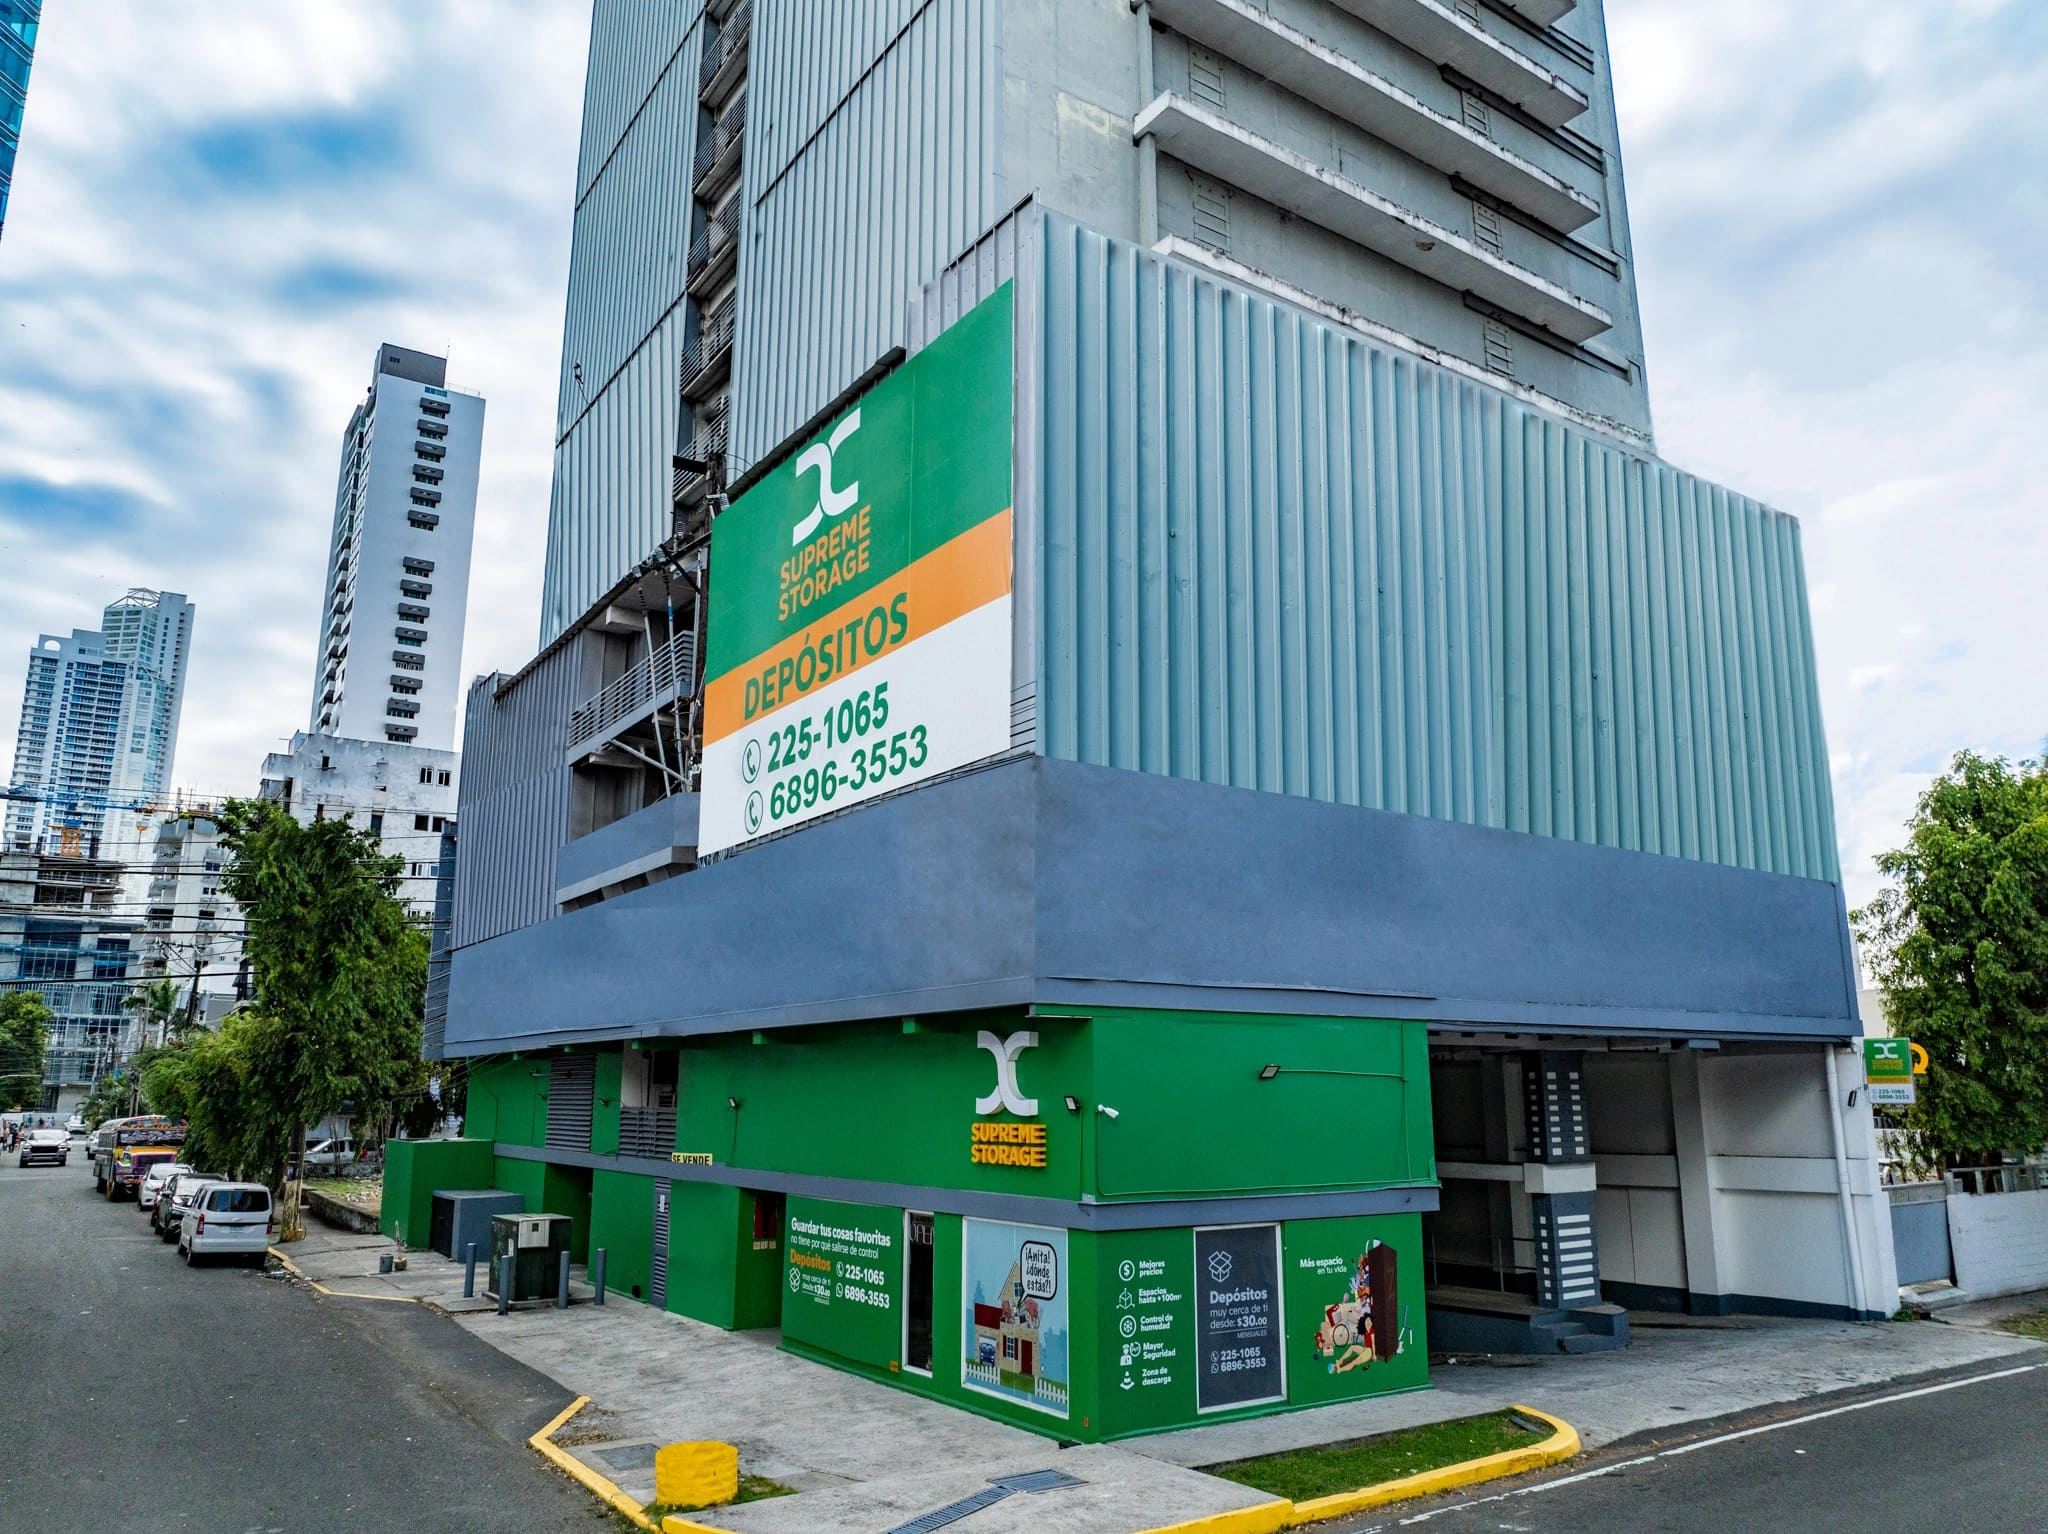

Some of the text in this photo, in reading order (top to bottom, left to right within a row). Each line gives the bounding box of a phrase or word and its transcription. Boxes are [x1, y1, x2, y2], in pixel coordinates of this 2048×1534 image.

[780, 505, 871, 589] SUPREME
[778, 541, 870, 621] STORAGE
[744, 592, 908, 720] DEPÓSITOS
[768, 681, 888, 773] 225-1065
[771, 724, 928, 820] 6896-3553
[971, 1122, 1046, 1143] SUPREME
[683, 1155, 710, 1166] VENDE
[971, 1144, 1047, 1167] STORAGE
[791, 1217, 891, 1247] Guardar tus cosas favoritas
[791, 1235, 797, 1243] no
[811, 1239, 820, 1249] por
[850, 1244, 857, 1256] de
[858, 1248, 879, 1259] control
[790, 1248, 831, 1272] Depósitos
[1025, 1247, 1050, 1264] ¡Anita!
[1300, 1256, 1343, 1268] Más espacio
[1026, 1262, 1050, 1279] ¿dónde
[1139, 1260, 1165, 1269] Mejores
[1334, 1265, 1347, 1273] vida
[845, 1264, 884, 1286] 225-1065
[1139, 1267, 1163, 1278] precios
[1027, 1279, 1051, 1294] estás?!
[1139, 1287, 1167, 1297] Espacios
[845, 1284, 890, 1308] 6896-3553
[1139, 1296, 1156, 1304] hasta
[1210, 1288, 1268, 1306] Depósitos
[1210, 1303, 1269, 1318] muy cerca de ti
[1140, 1314, 1173, 1324] Control de
[1210, 1315, 1268, 1329] desde: $30.00
[1141, 1322, 1171, 1332] humedad
[1143, 1342, 1164, 1351] Mayor
[1143, 1348, 1176, 1360] Seguridad
[1221, 1346, 1260, 1361] 225-1065
[1142, 1366, 1168, 1377] Zona de
[1221, 1357, 1266, 1372] 6896-3553
[1142, 1376, 1172, 1386] descarga
